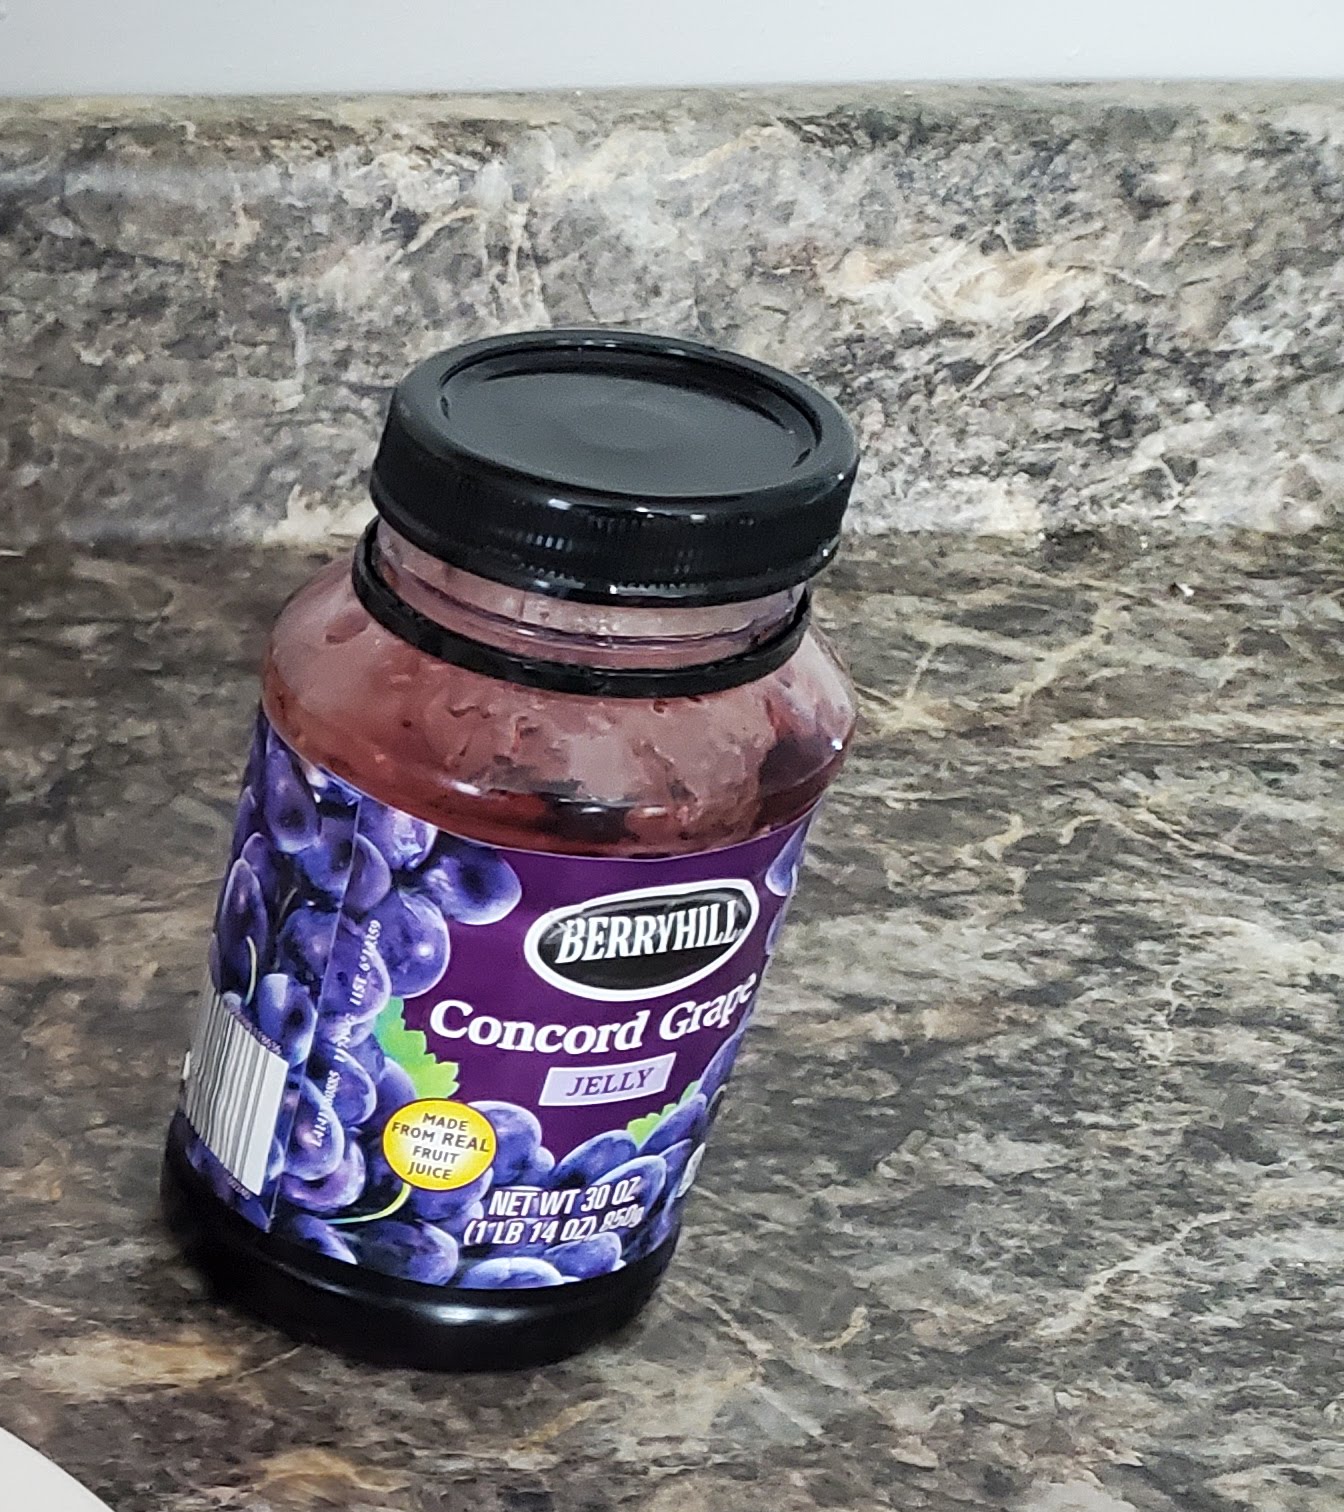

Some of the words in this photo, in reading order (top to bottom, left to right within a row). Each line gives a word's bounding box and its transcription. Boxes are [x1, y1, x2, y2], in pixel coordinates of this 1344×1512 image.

[554, 899, 739, 965] BERRYHILL
[429, 1000, 652, 1055] Concord
[659, 973, 758, 1042] Grape
[566, 1067, 655, 1097] JELLY
[392, 1121, 436, 1143] FROM
[441, 1132, 491, 1153] REAL
[422, 1112, 469, 1132] MADE
[412, 1145, 461, 1164] FRUIT
[407, 1161, 454, 1181] JUICE
[488, 1190, 539, 1217] NET
[538, 1188, 582, 1216] WT
[580, 1184, 611, 1213] 30
[611, 1175, 643, 1206] OZ
[463, 1219, 489, 1247] (1
[491, 1220, 526, 1246] LB
[528, 1220, 560, 1244] 14
[559, 1215, 598, 1242] OZ)
[598, 1203, 646, 1233] 850g
